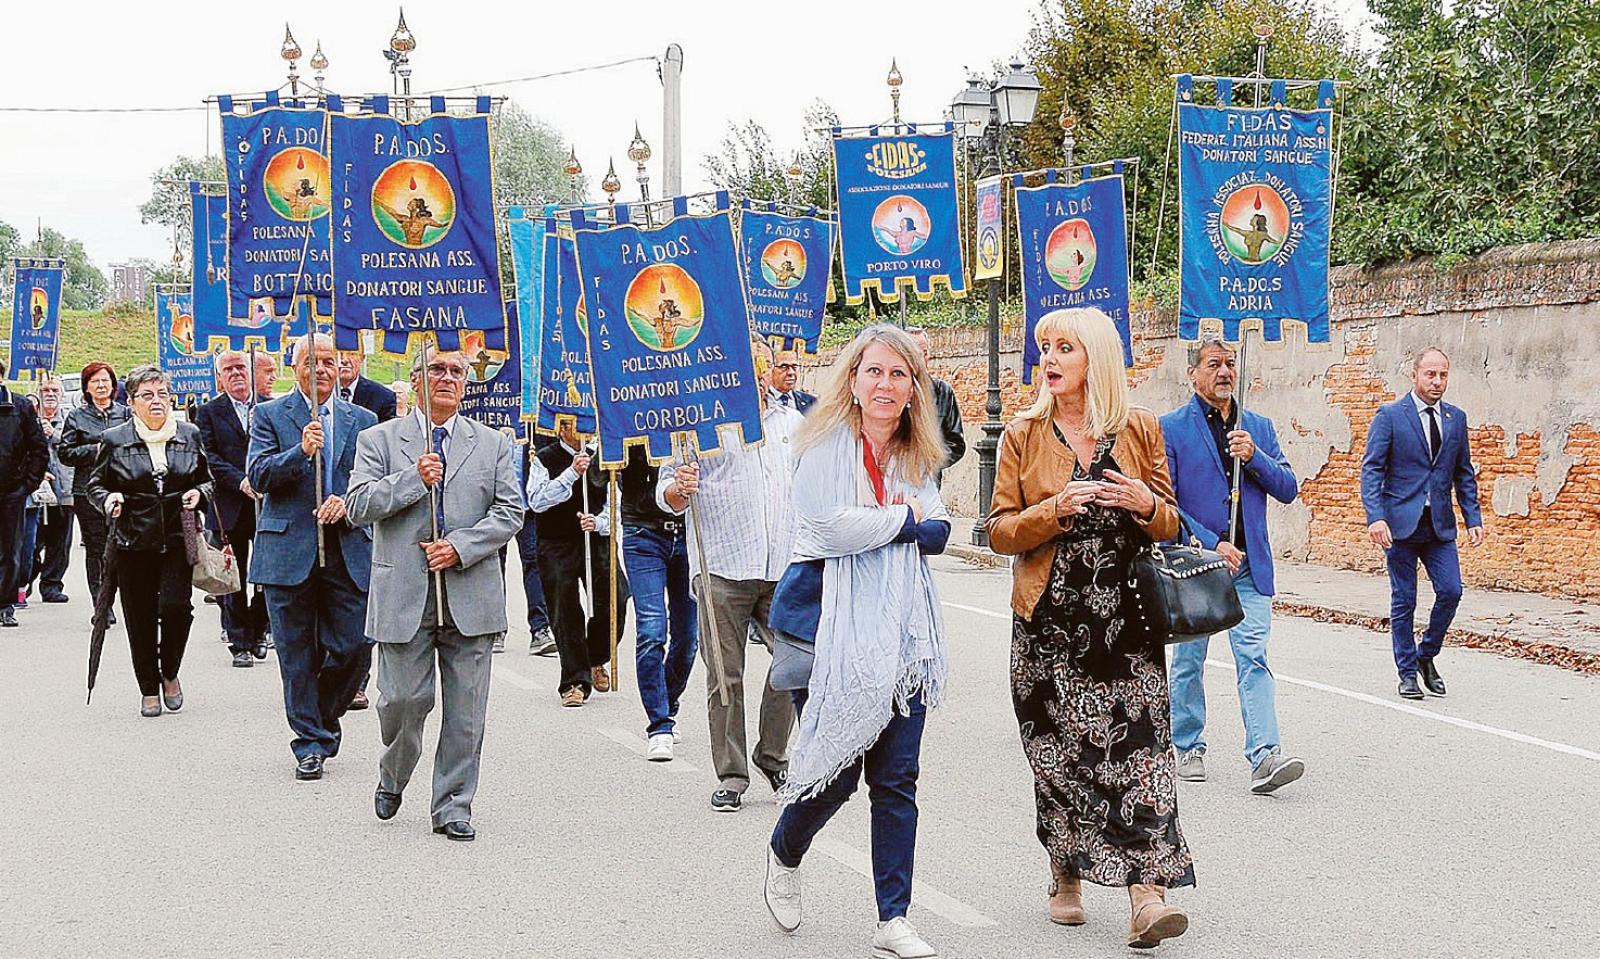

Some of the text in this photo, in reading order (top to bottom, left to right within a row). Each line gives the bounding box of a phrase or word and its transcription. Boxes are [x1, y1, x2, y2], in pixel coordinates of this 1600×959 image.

[1227, 113, 1293, 131] FIDAS
[1233, 134, 1289, 147] ITALIANA
[871, 141, 920, 171] FIDAS
[1202, 150, 1313, 164] DONATORI SANGUE
[866, 162, 928, 179] POLESANA
[342, 163, 353, 243] FIDAS
[1265, 172, 1304, 218] DONATORI
[252, 226, 316, 240] POLESANA
[245, 250, 301, 263] DONATORI
[361, 250, 476, 269] POLESANA ASS.
[867, 259, 942, 273] PORTO VIRO
[346, 279, 488, 297] DONATORI SANGUE
[1228, 295, 1273, 310] ADRIA
[371, 306, 468, 330] FASANA
[594, 276, 611, 351] FIDAS
[621, 345, 728, 374] POLESANA ASS.
[610, 371, 741, 402] DONATORI SANGUE
[483, 396, 521, 408] SANGUE
[634, 400, 726, 431] CORBOLA
